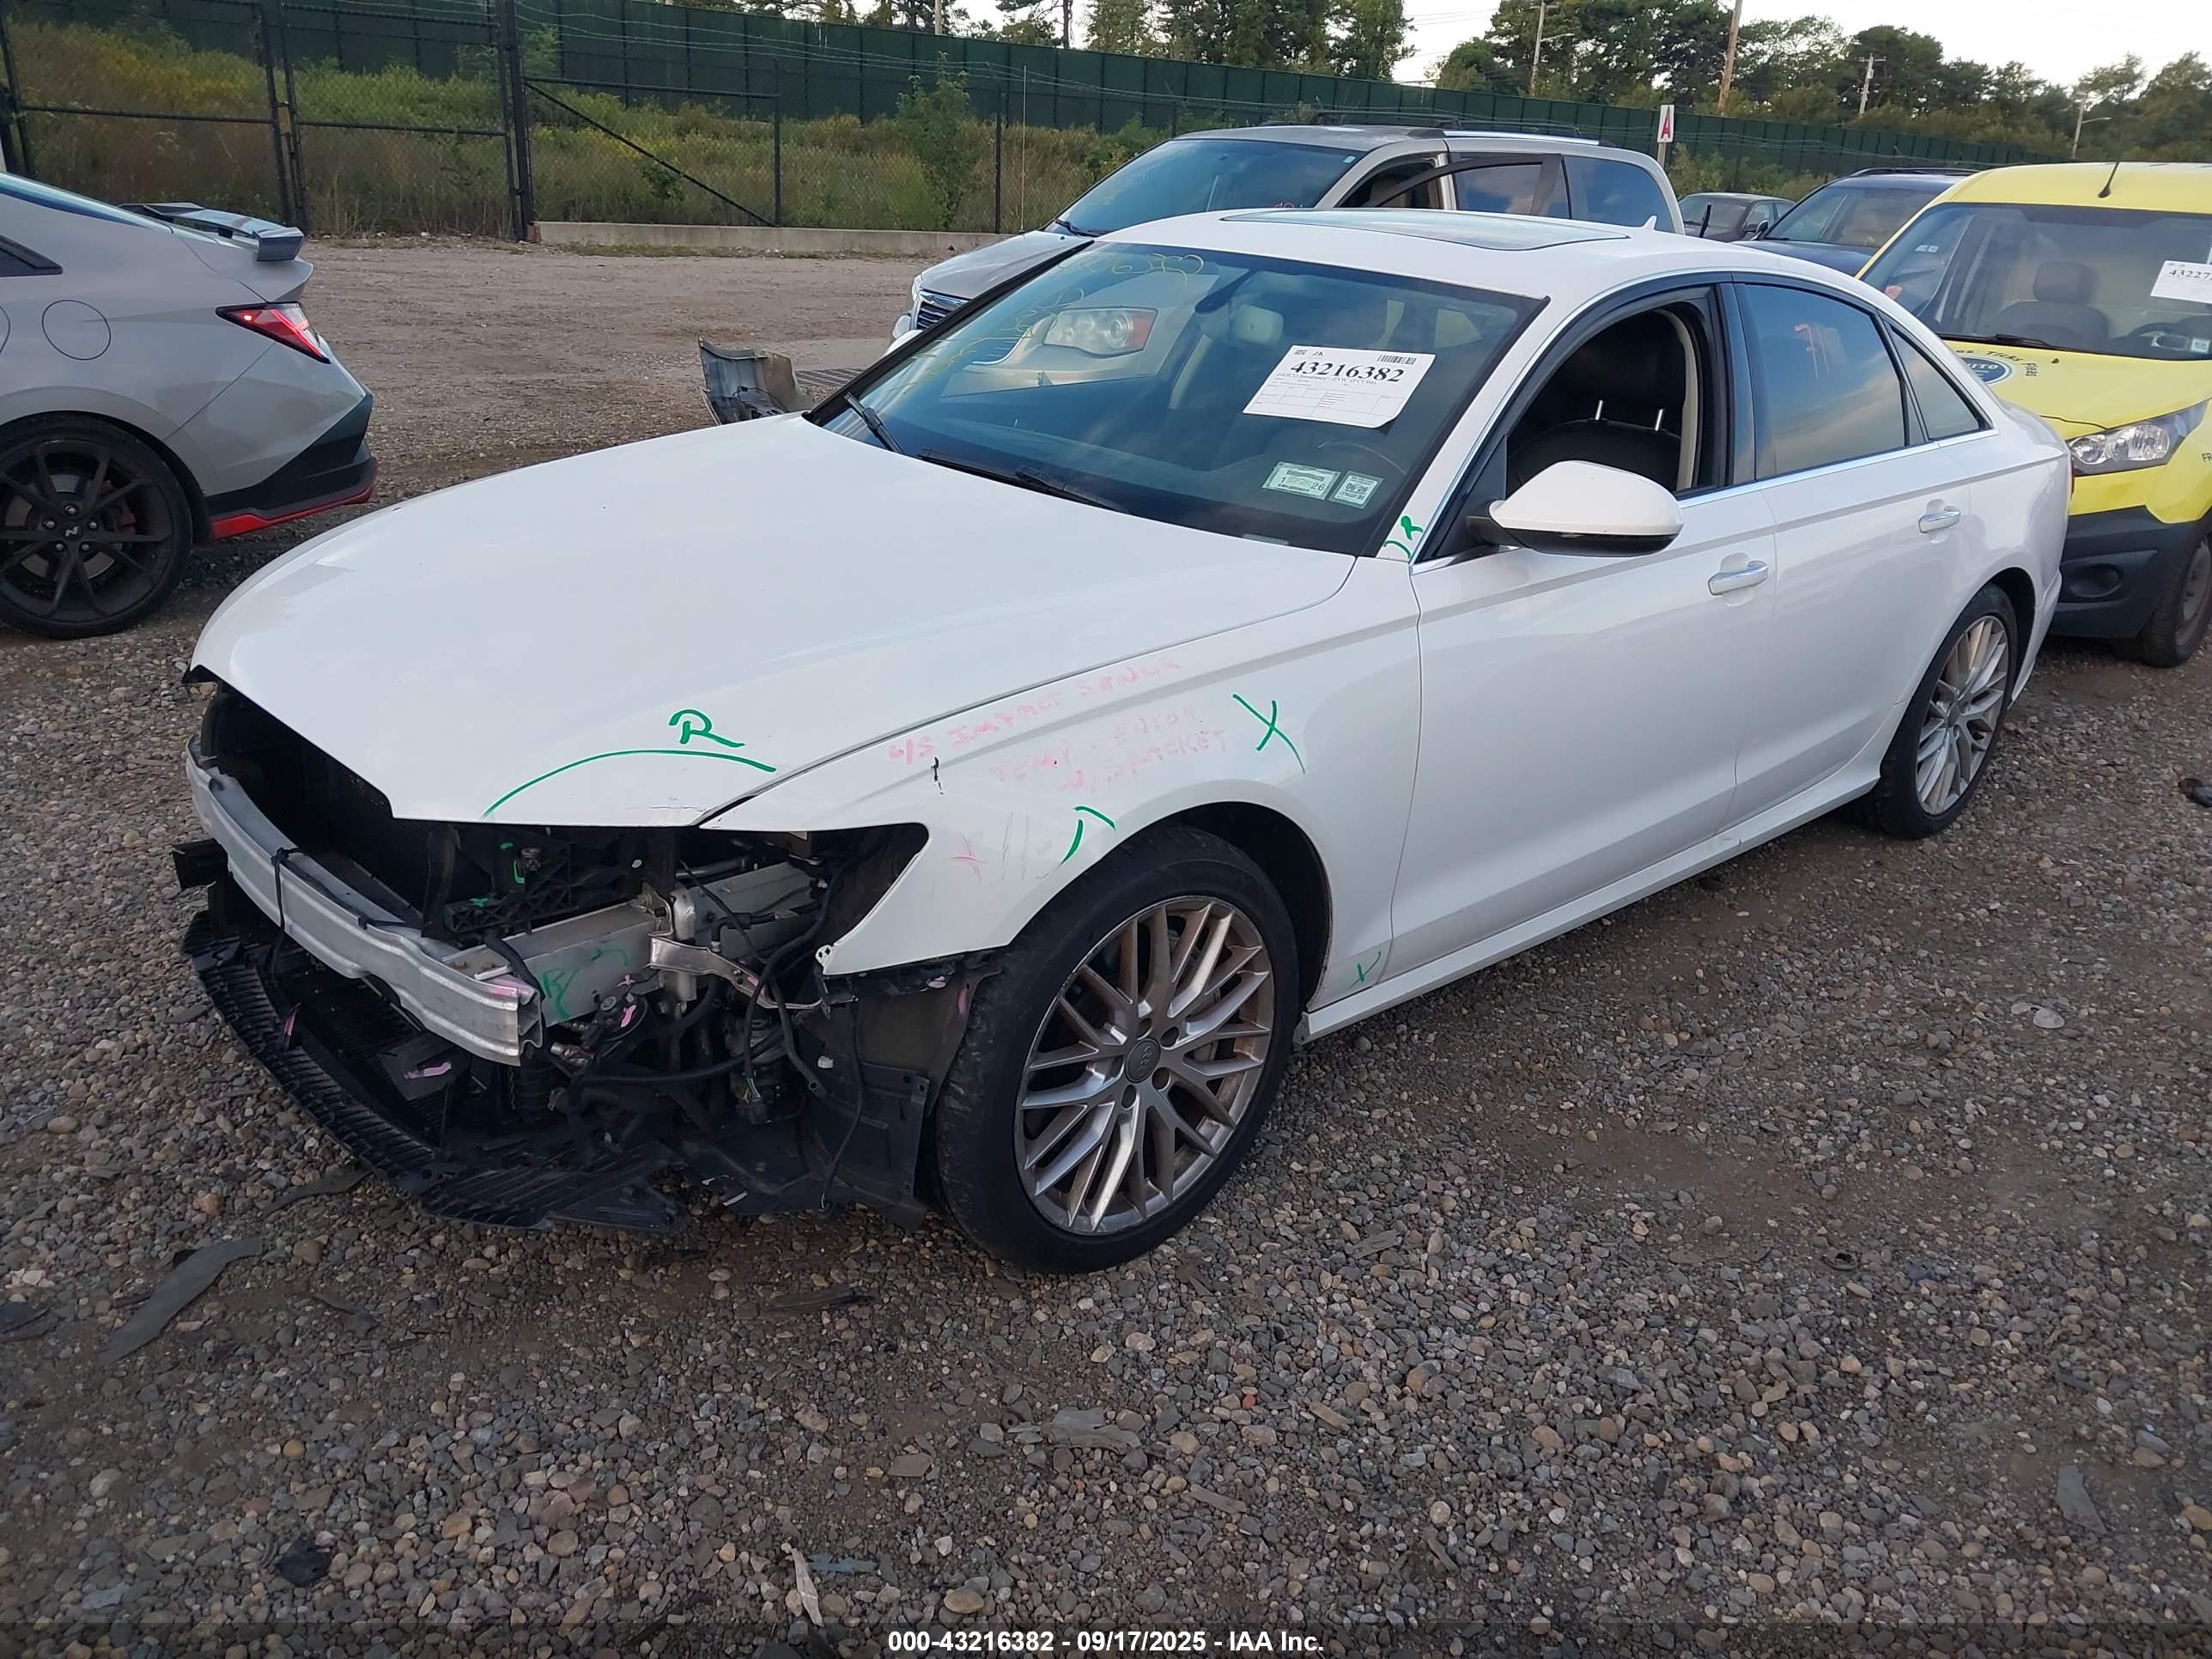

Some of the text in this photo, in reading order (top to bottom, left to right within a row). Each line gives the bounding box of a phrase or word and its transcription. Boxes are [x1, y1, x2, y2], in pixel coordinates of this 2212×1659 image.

[1661, 106, 1671, 139] A
[2168, 269, 2212, 281] 43227
[1291, 360, 1405, 383] 43216382
[1310, 482, 1326, 491] 26
[668, 708, 745, 748] R
